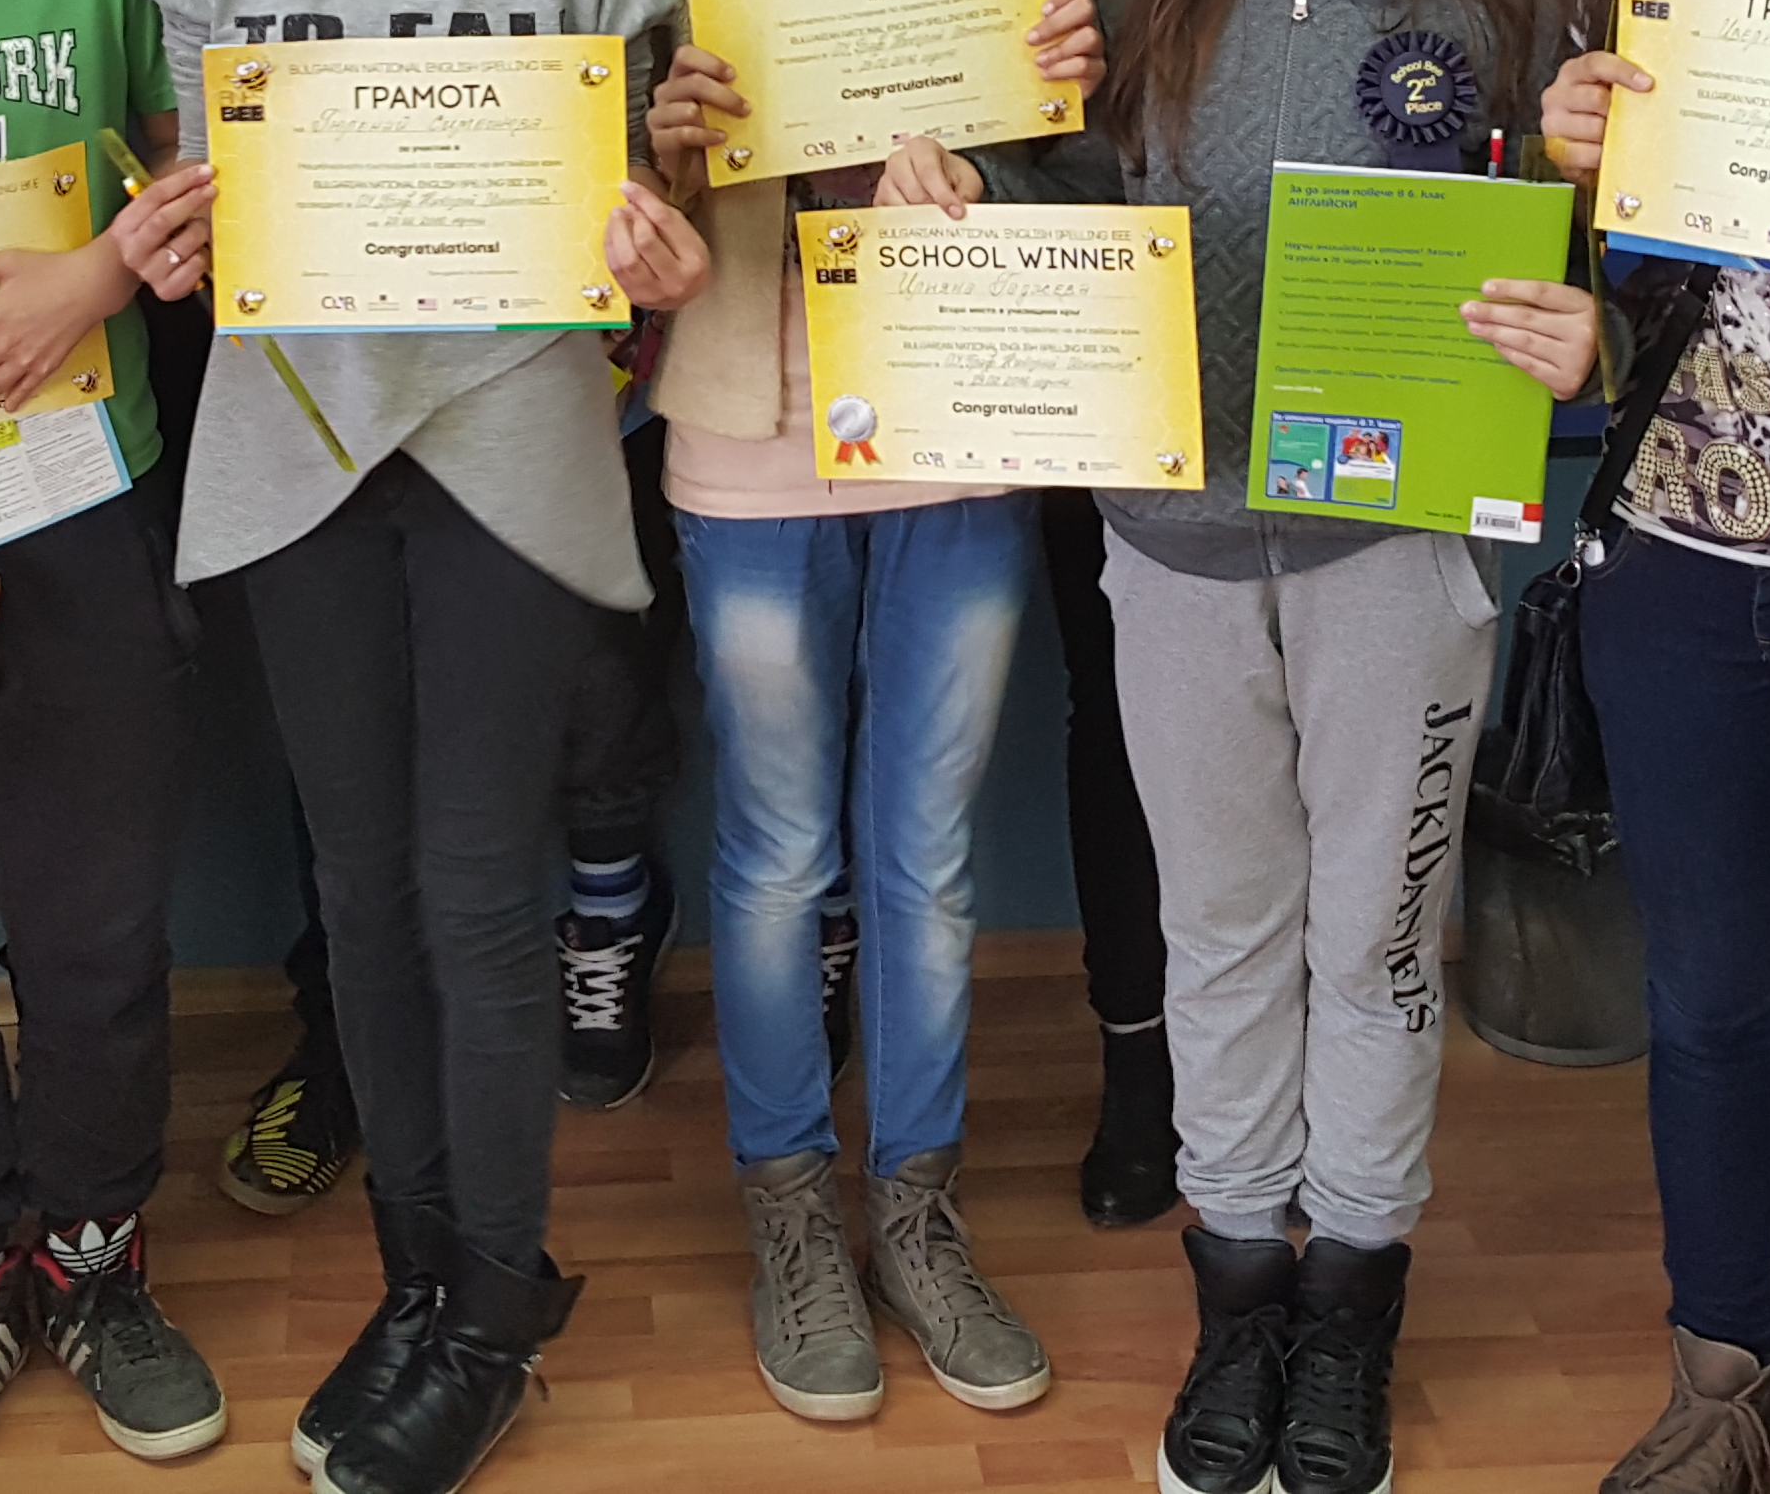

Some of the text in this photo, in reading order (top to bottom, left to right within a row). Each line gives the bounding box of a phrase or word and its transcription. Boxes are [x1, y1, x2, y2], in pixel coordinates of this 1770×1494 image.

[1632, 0, 1670, 19] BEE
[1391, 60, 1444, 83] School Bee
[841, 73, 964, 100] Congratulations!
[1407, 75, 1437, 101] 2nd
[354, 84, 500, 109] ГРАМОТА
[1405, 101, 1443, 115] Place
[1288, 198, 1357, 208] АНГЛИЙСКИ
[365, 241, 500, 258] Congratulations!
[879, 246, 1135, 271] SCHOOL WINNER
[816, 268, 857, 284] BEE
[952, 401, 1078, 417] Congratulations!
